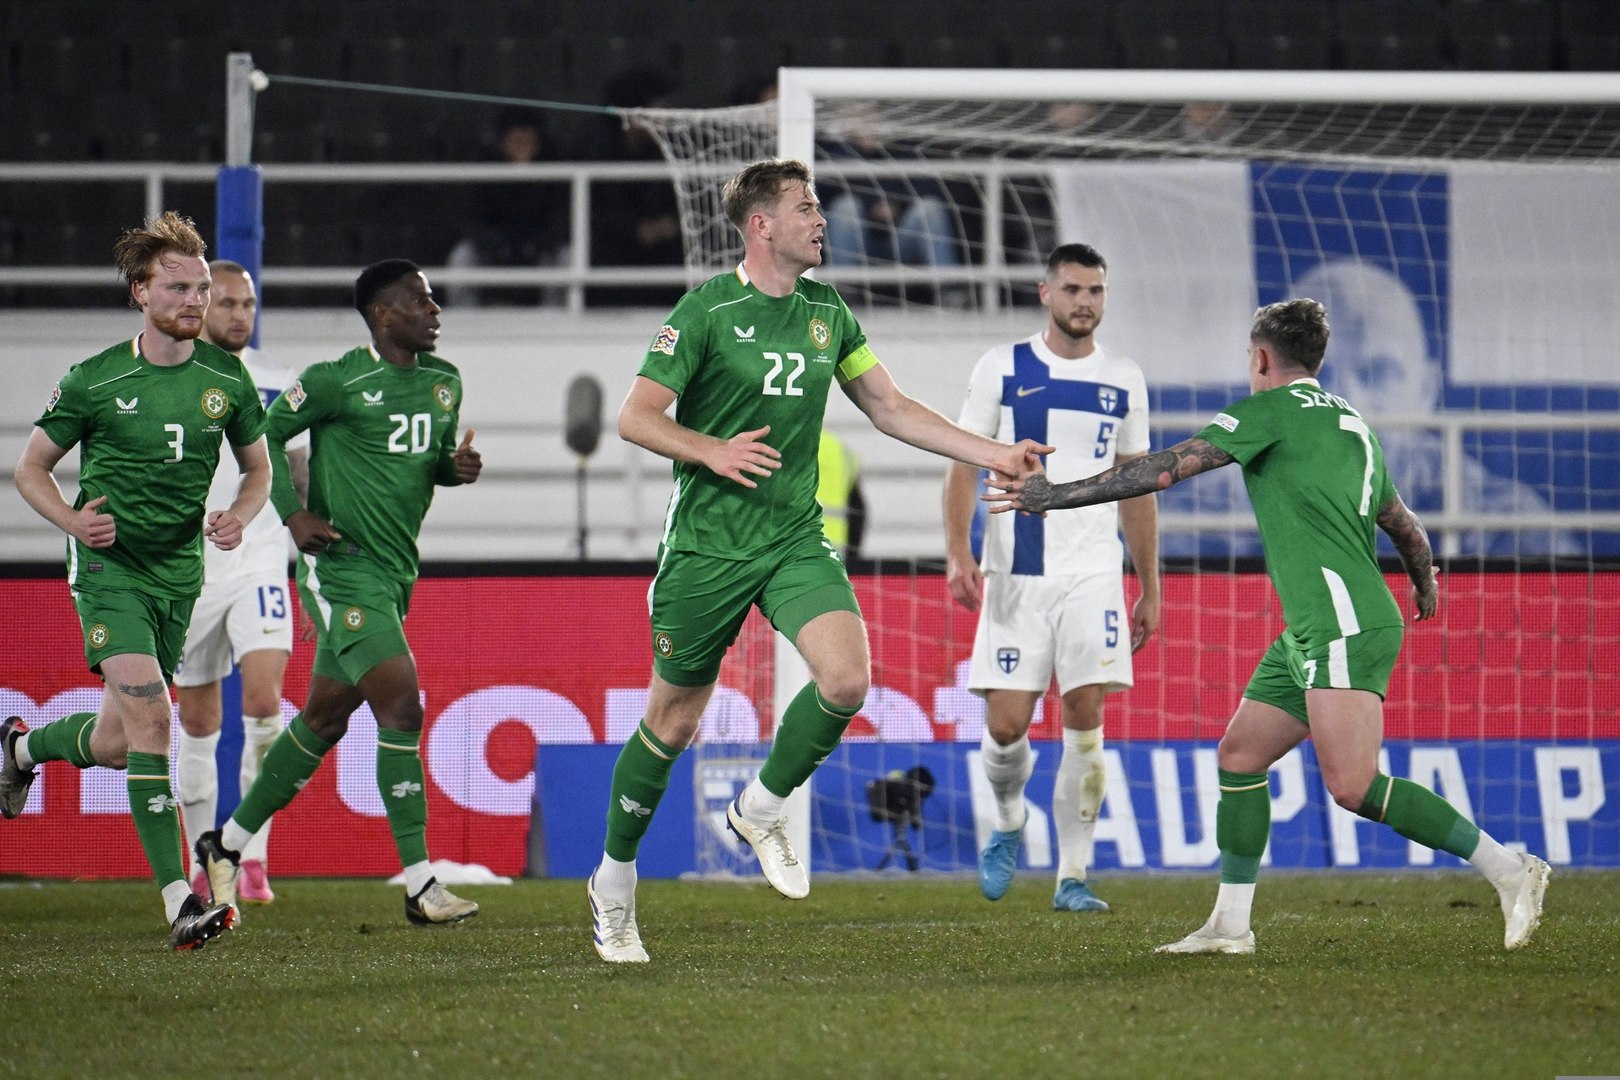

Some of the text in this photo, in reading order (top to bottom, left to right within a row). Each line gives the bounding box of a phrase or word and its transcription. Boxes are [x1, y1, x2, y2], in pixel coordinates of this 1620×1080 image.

[762, 352, 806, 396] 22
[164, 423, 184, 463] 3
[388, 413, 432, 454] 20
[1094, 422, 1113, 459] 5
[1339, 414, 1373, 516] 7
[258, 586, 286, 618] 13
[1105, 610, 1118, 648] 5
